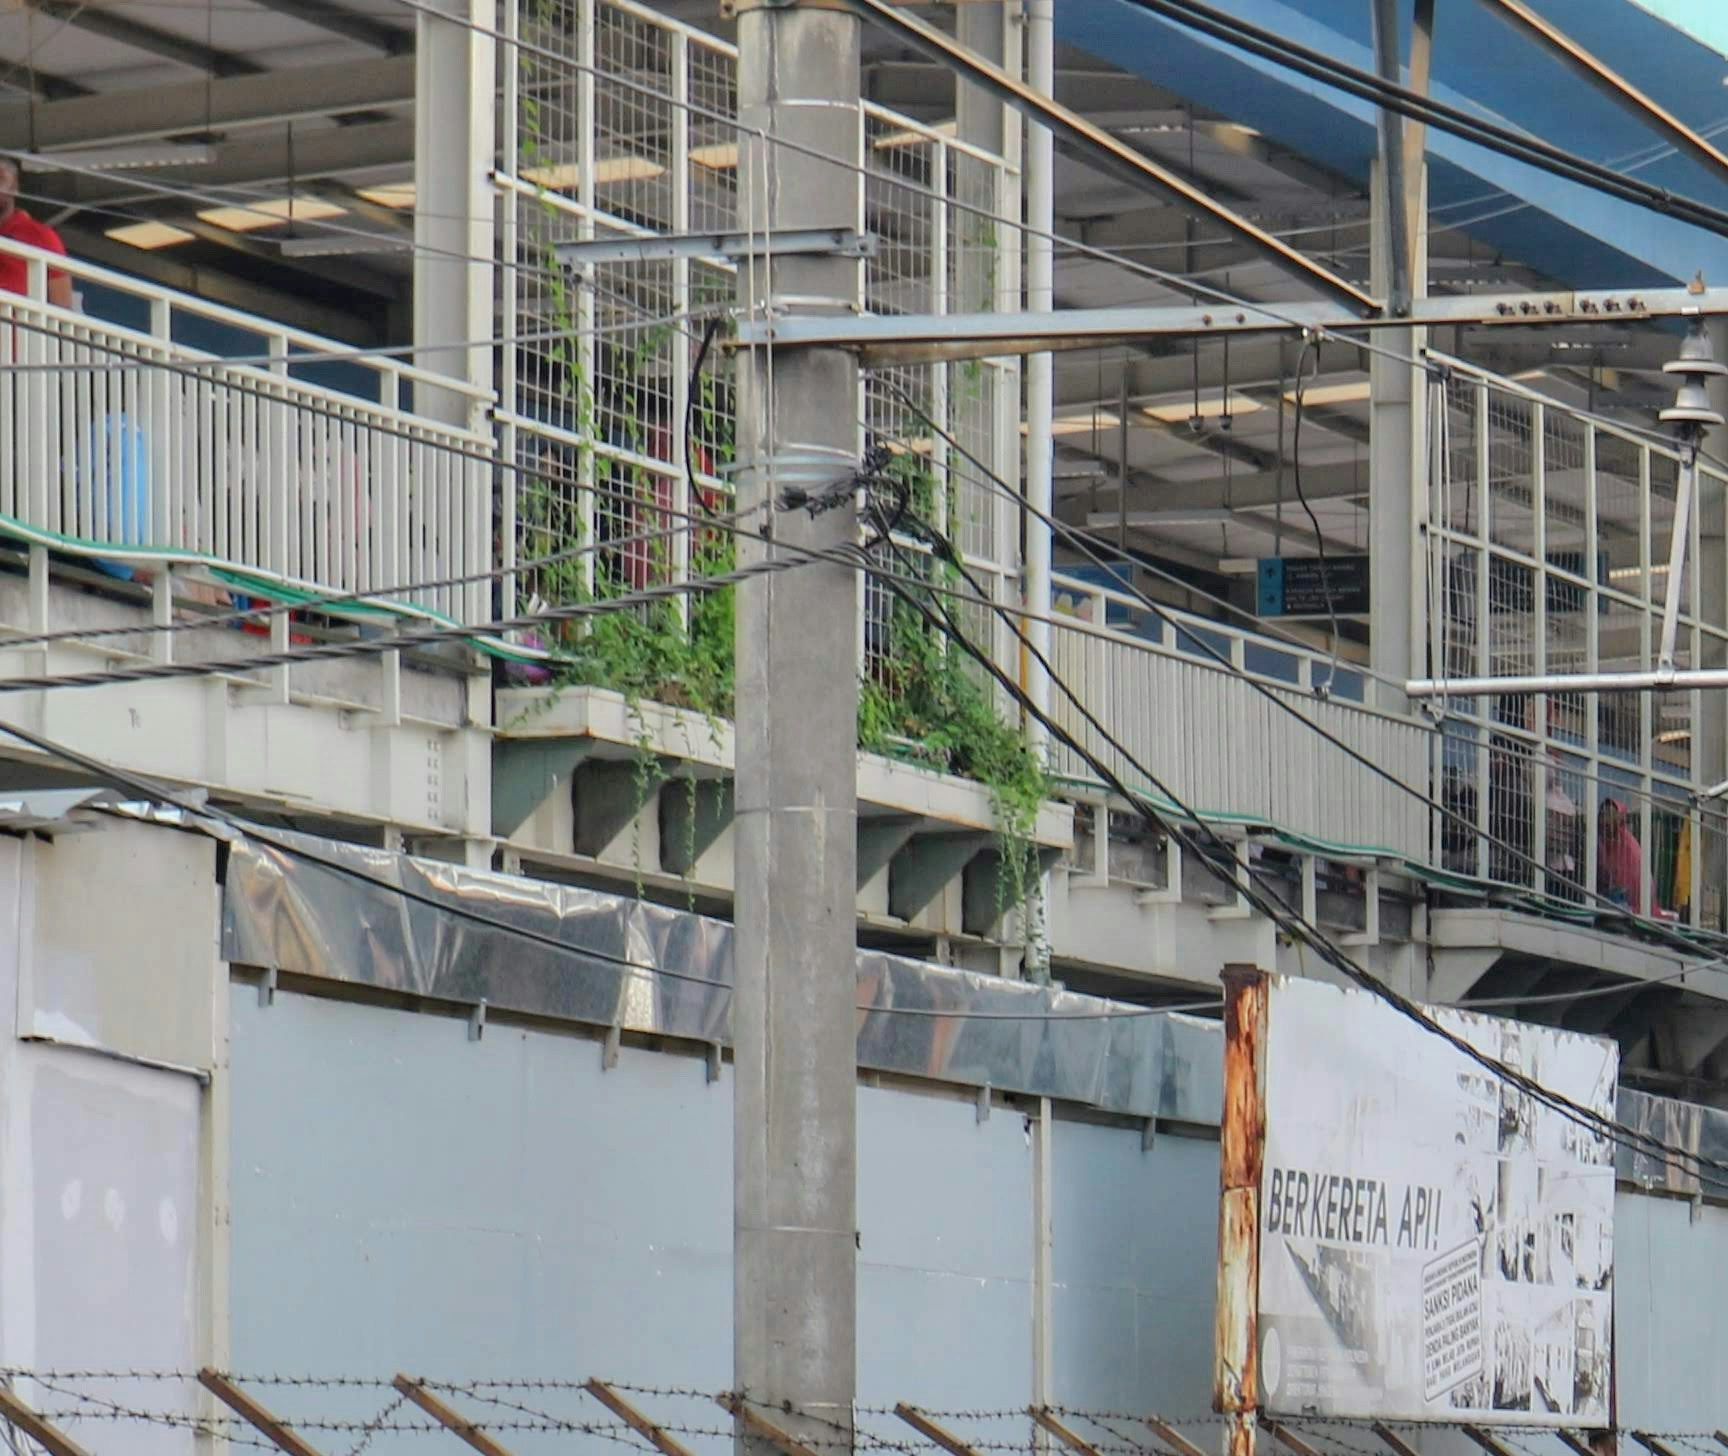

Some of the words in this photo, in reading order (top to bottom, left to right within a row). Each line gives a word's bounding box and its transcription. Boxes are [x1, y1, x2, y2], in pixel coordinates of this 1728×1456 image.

[1268, 1167, 1388, 1245] BERKERETA
[1424, 1287, 1450, 1320] SANKSI
[1451, 1272, 1479, 1305] PIDANA
